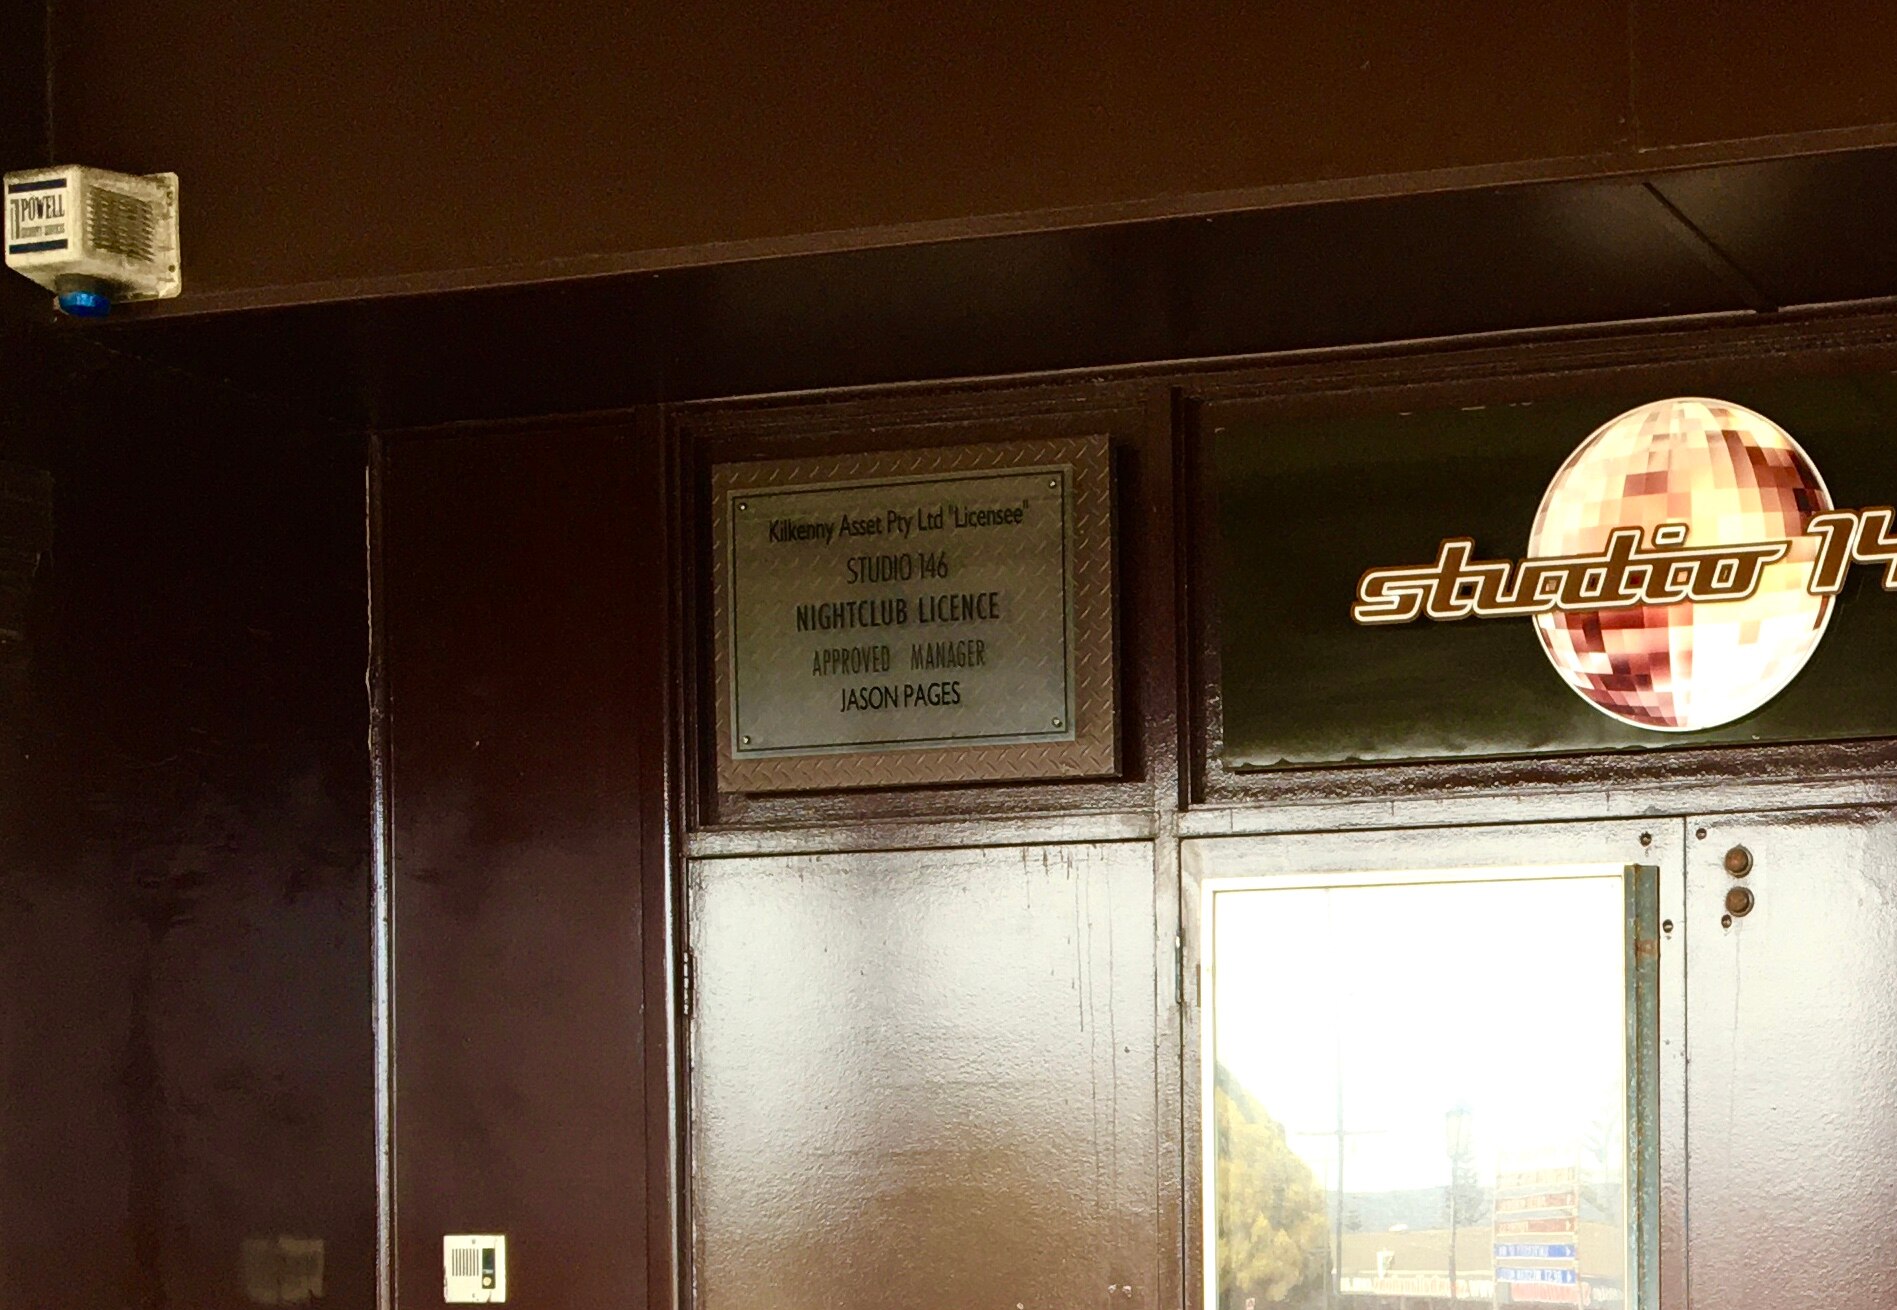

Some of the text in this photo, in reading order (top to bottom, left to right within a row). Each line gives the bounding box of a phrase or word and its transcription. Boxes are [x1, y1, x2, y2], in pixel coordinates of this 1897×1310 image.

[768, 518, 835, 545] Kilkenny
[838, 513, 882, 538] Asset
[886, 509, 913, 539] Pty
[917, 506, 944, 532] Ltd
[846, 551, 949, 584] STUDIO 146
[1352, 522, 1793, 626] studio
[796, 591, 1000, 633] NIGHTCLUB LICENCE
[812, 639, 987, 677] APPROVED MANAGER
[839, 680, 961, 713] JASON PAGES
